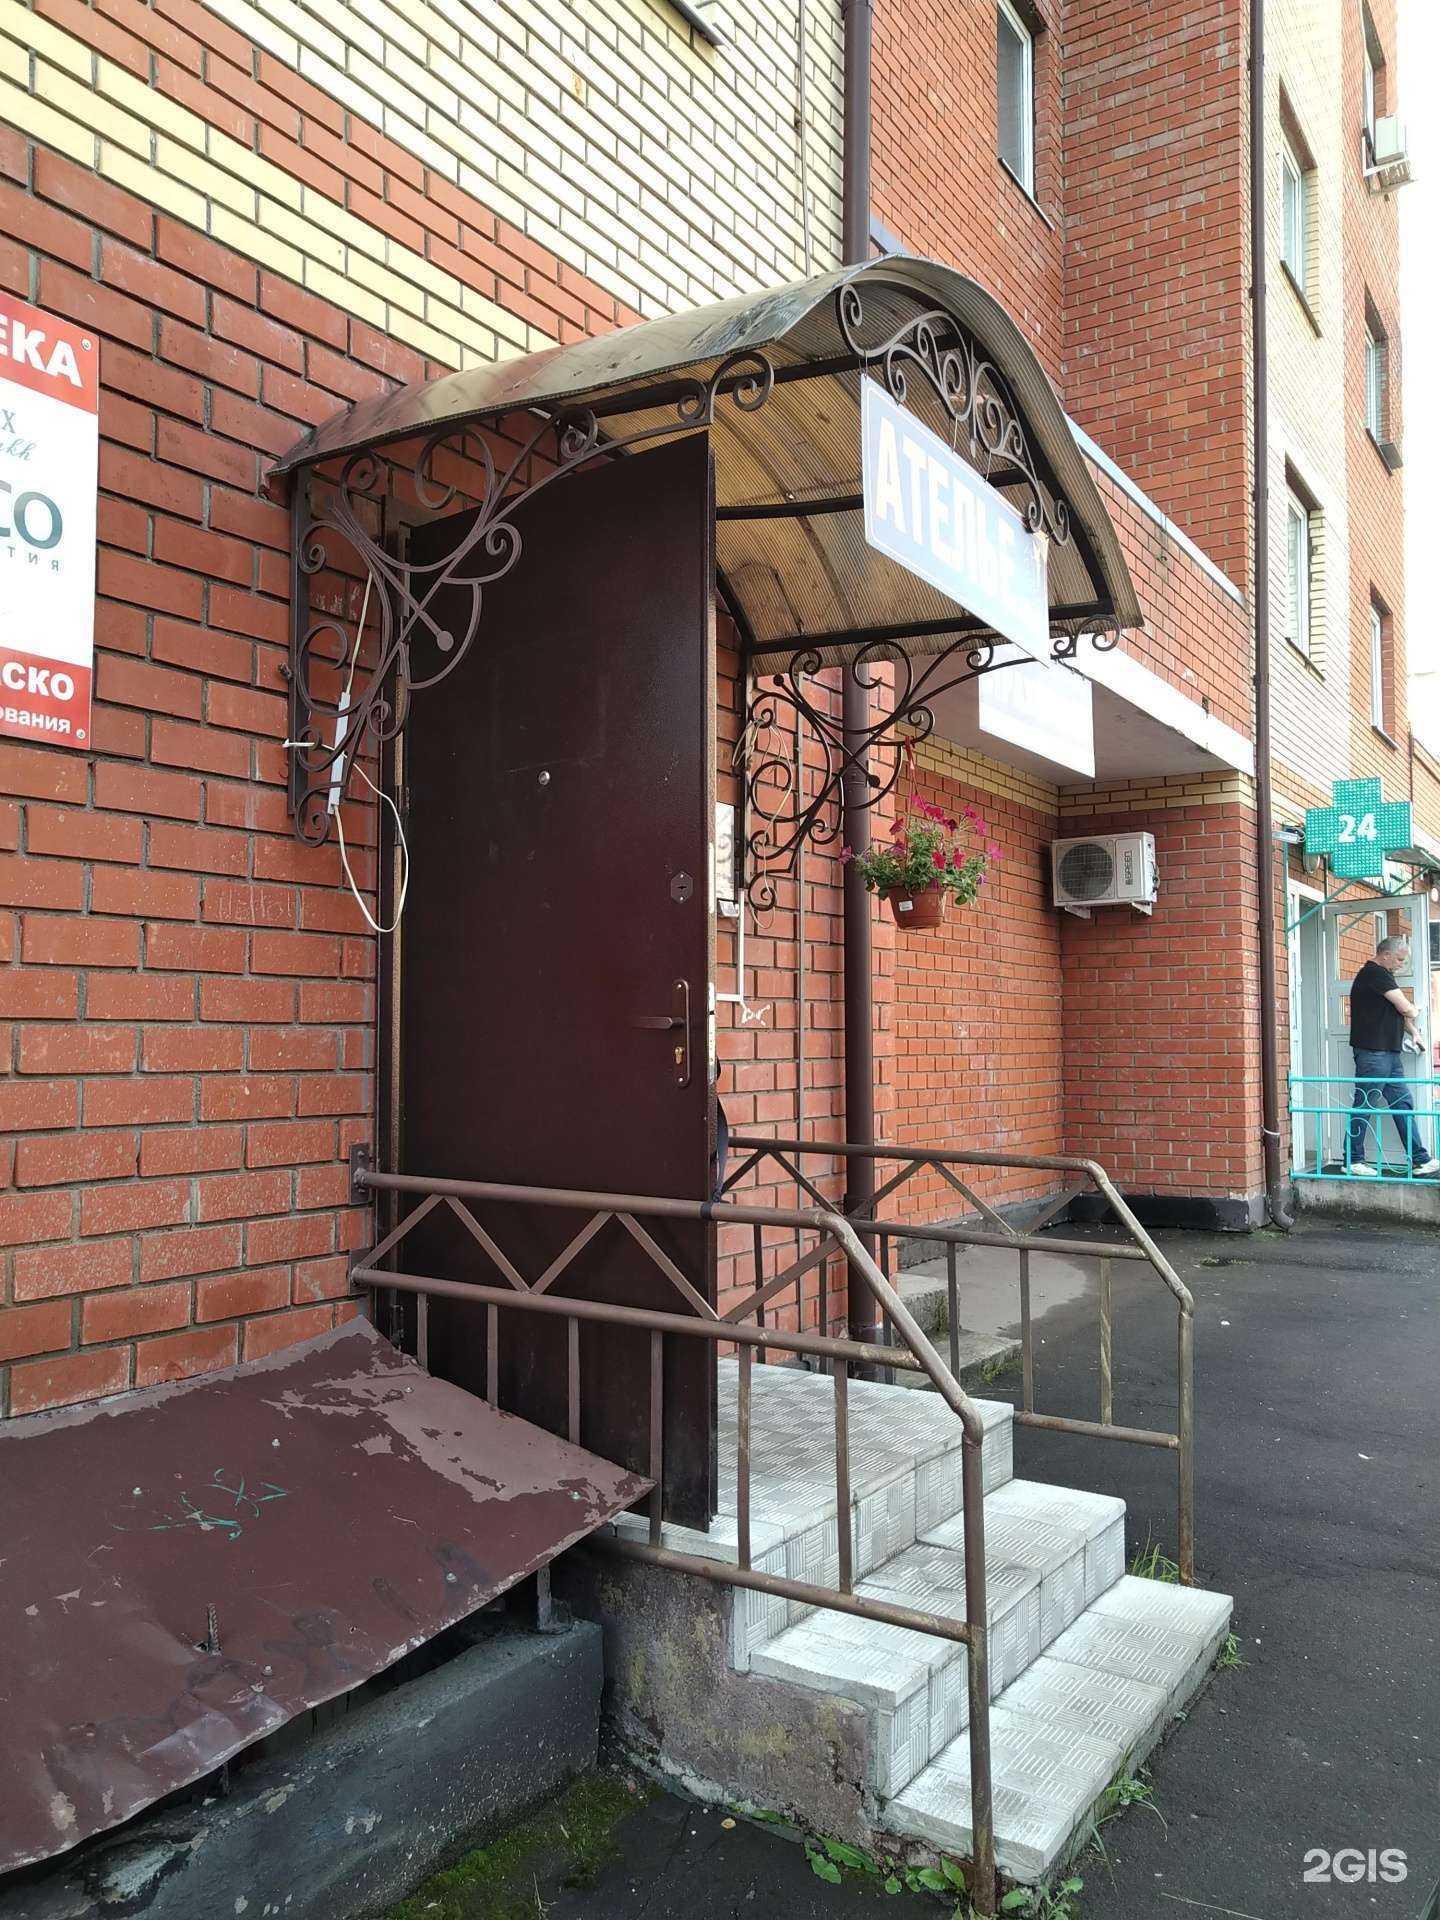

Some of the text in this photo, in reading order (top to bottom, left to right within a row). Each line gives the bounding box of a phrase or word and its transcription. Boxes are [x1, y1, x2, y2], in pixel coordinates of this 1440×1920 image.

[875, 414, 1016, 600] АТЕЛЬЕ
[0, 704, 71, 734] вания
[1337, 811, 1378, 844] 24
